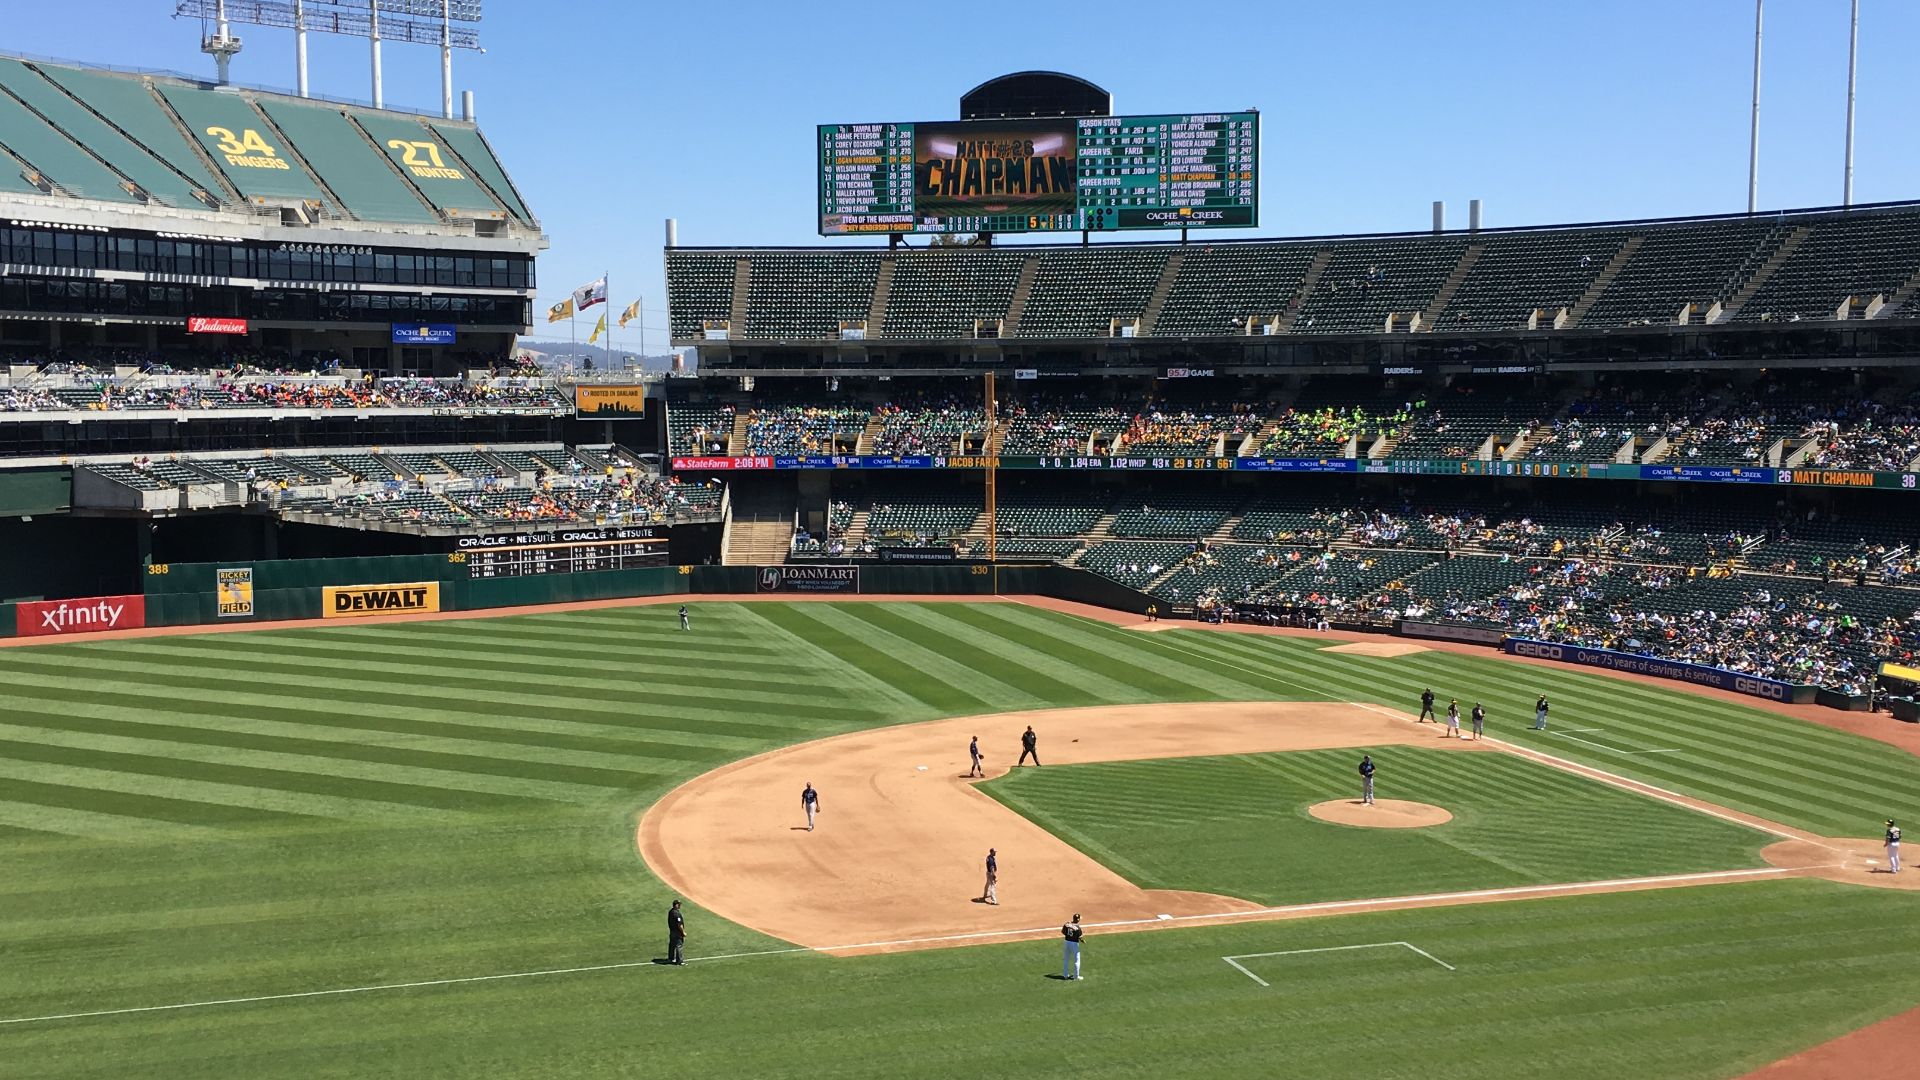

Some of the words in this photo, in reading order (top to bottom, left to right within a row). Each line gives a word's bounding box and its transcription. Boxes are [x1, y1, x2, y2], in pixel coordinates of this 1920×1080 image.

[207, 127, 275, 156] 34
[388, 140, 445, 167] 27
[1079, 148, 1101, 156] CAREER
[225, 155, 290, 170] FINGERS
[410, 167, 464, 180] HUNTER
[922, 157, 1070, 196] CHAPMAN
[1030, 217, 1036, 228] 5
[191, 318, 244, 332] Budweiser
[735, 458, 753, 468] 2:06
[755, 458, 768, 467] PM
[935, 457, 946, 467] 34
[948, 457, 973, 467] JACOB
[1040, 458, 1046, 467] 4
[1070, 458, 1088, 467] 1.84
[1089, 459, 1101, 467] ERA
[1110, 458, 1127, 468] 1.02
[1129, 459, 1146, 467] WHIP
[1153, 459, 1163, 468] 43
[1174, 459, 1184, 468] 29
[1194, 460, 1204, 468] 37
[1217, 460, 1228, 469] 66
[1461, 463, 1467, 473] 5
[1507, 464, 1512, 474] B
[1516, 465, 1520, 474] 1
[1525, 465, 1531, 475] S
[1779, 471, 1791, 482] 26
[1793, 471, 1819, 485] MATT
[1823, 472, 1873, 486] CHAPMAN
[1902, 475, 1915, 487] 3B
[459, 537, 506, 546] ORACLE
[517, 534, 556, 543] NETSUITE
[563, 532, 607, 541] ORACLE
[617, 529, 652, 538] NETSUITE
[448, 554, 465, 562] 362
[148, 564, 169, 575] 388
[679, 566, 694, 574] 367
[971, 567, 987, 575] 330
[222, 604, 249, 612] FIELD
[41, 600, 123, 631] xfinity
[1515, 642, 1562, 659] GEICO
[1577, 651, 1598, 663] Over
[1601, 652, 1612, 665] 75
[1614, 656, 1636, 670] years
[1639, 658, 1648, 670] of
[1650, 663, 1682, 678] savings
[1684, 668, 1692, 679] &
[1693, 670, 1721, 684] service
[1735, 677, 1782, 698] GEICO
